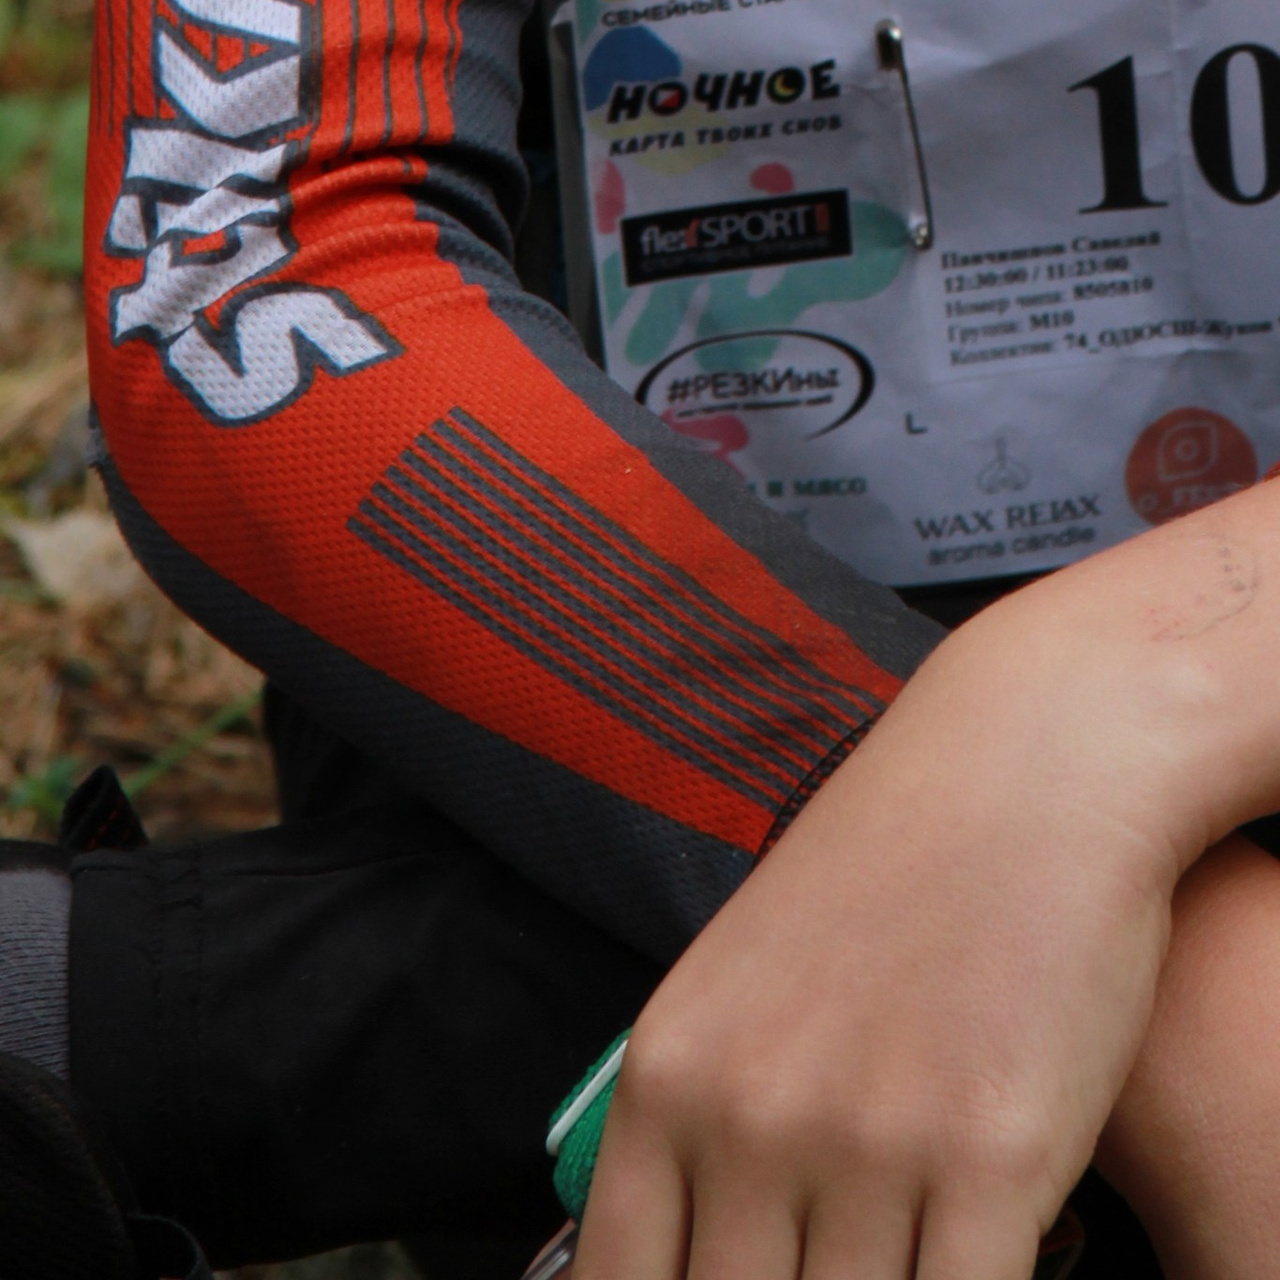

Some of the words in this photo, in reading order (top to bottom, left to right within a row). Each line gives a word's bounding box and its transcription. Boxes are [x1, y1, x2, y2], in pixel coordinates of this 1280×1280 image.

[607, 58, 841, 124] НОЧНОЕ
[609, 131, 686, 157] КАРТА
[913, 509, 994, 540] WAX
